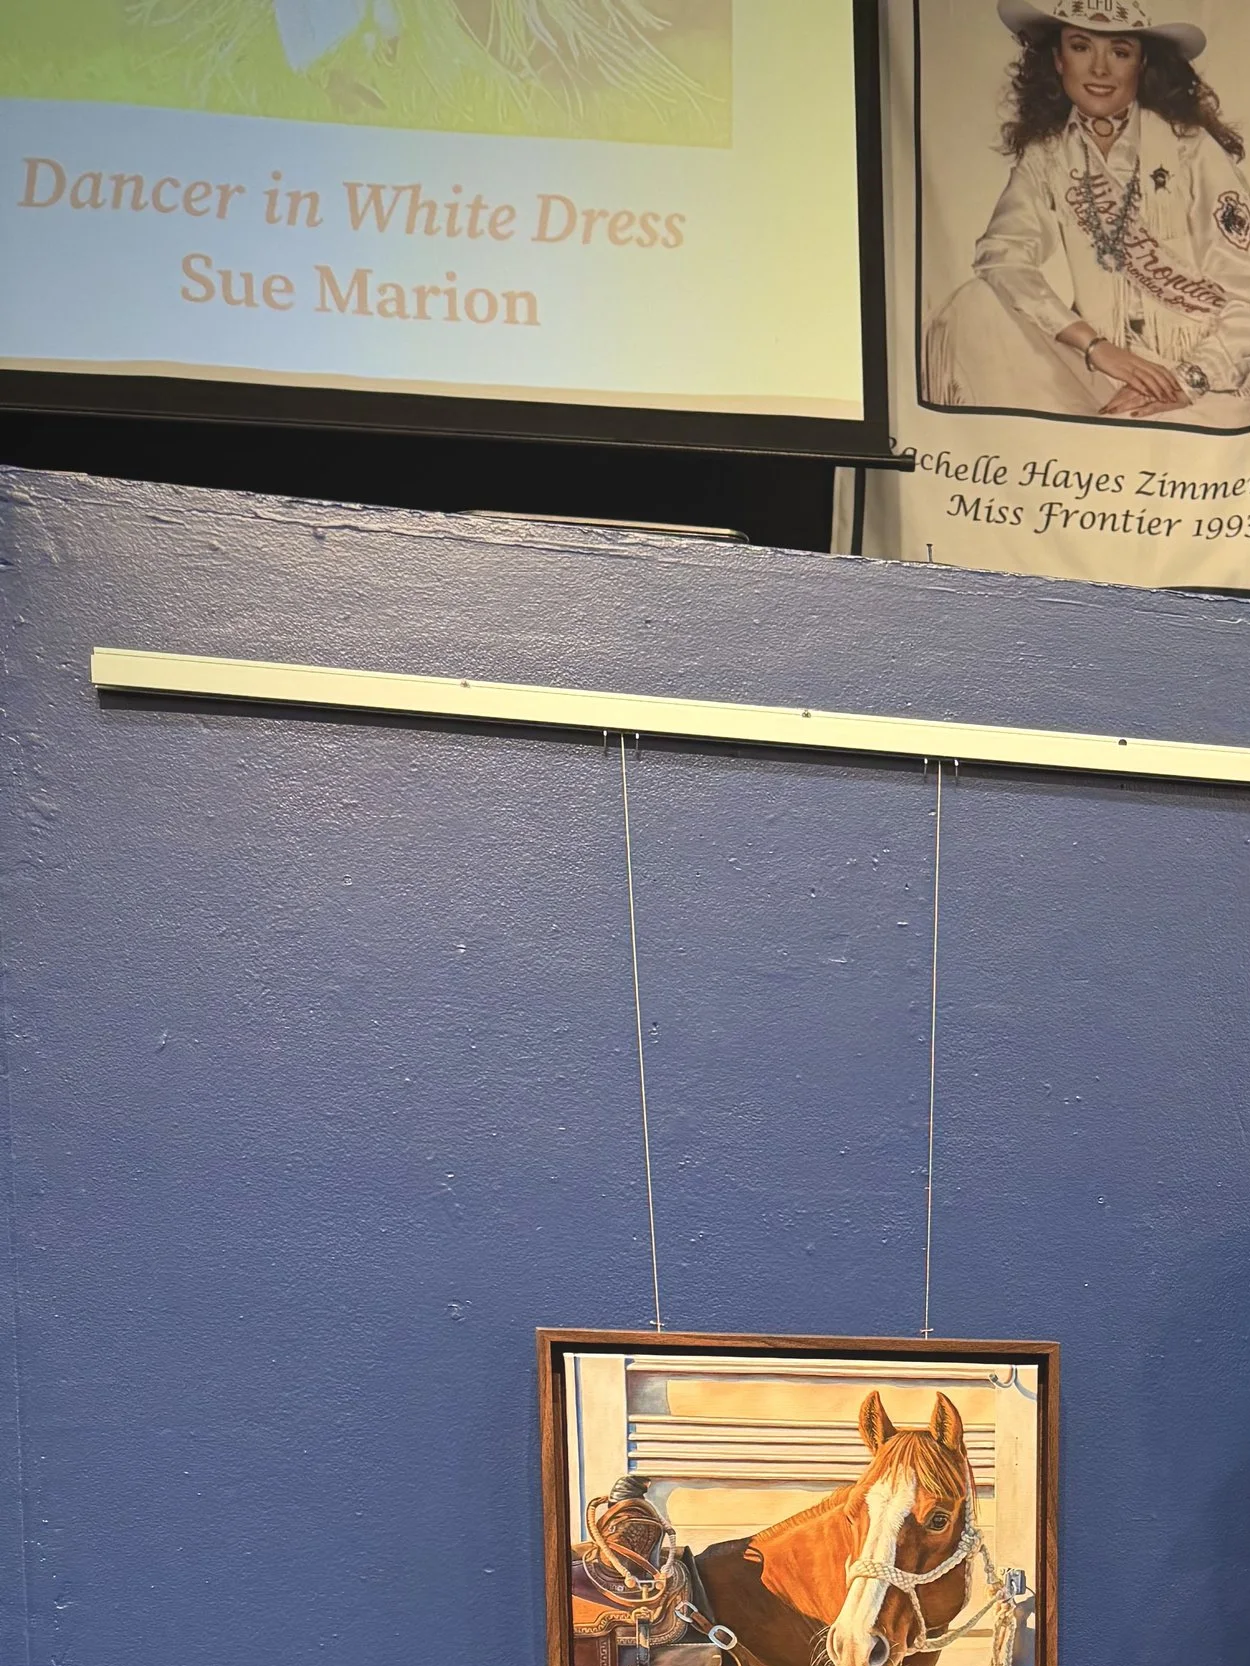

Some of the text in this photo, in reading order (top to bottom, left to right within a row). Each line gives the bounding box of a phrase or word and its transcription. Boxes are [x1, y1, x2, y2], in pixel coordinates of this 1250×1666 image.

[17, 157, 687, 249] Dancer in White Dress
[180, 253, 541, 326] Sue Marion
[1018, 458, 1125, 500] Hayes
[946, 494, 1024, 526] Miss
[1033, 502, 1182, 537] Frontier
